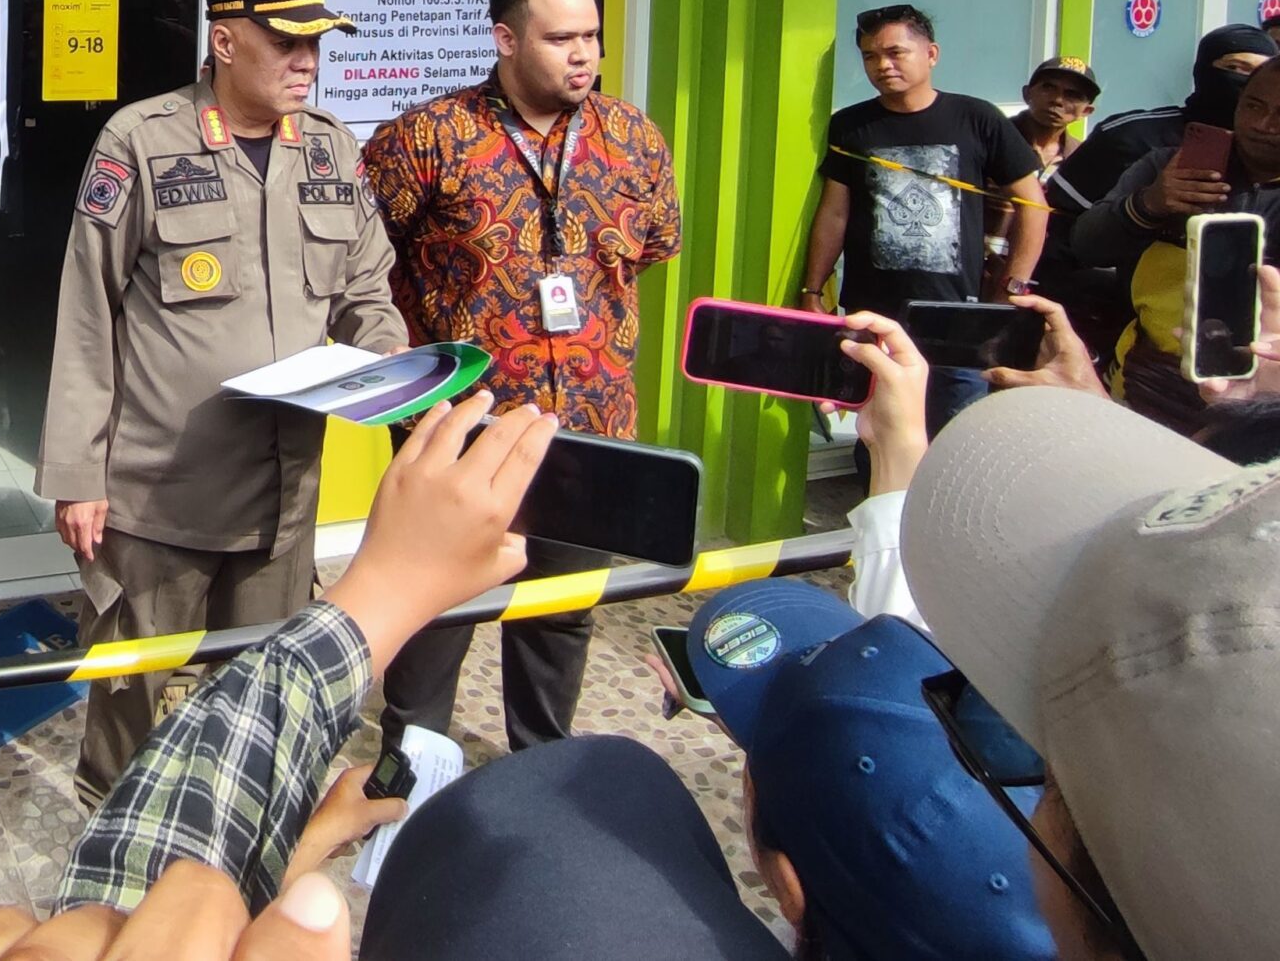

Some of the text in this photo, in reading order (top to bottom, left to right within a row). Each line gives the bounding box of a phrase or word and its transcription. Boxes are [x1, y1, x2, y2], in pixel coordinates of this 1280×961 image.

[391, 9, 452, 24] Penetapan
[454, 8, 482, 21] Tarif
[397, 25, 409, 38] di
[412, 24, 459, 37] Provinsi
[67, 37, 104, 53] 9-18
[328, 47, 498, 63] Seluruh Aktivitas Operasion
[344, 65, 491, 81] DILARANG Selama Mas
[324, 86, 369, 101] Hingga
[371, 85, 418, 99] adanya
[392, 100, 421, 111] Huk
[158, 185, 221, 205] EDWIN
[302, 187, 331, 202] POL
[716, 624, 768, 657] EIGER
